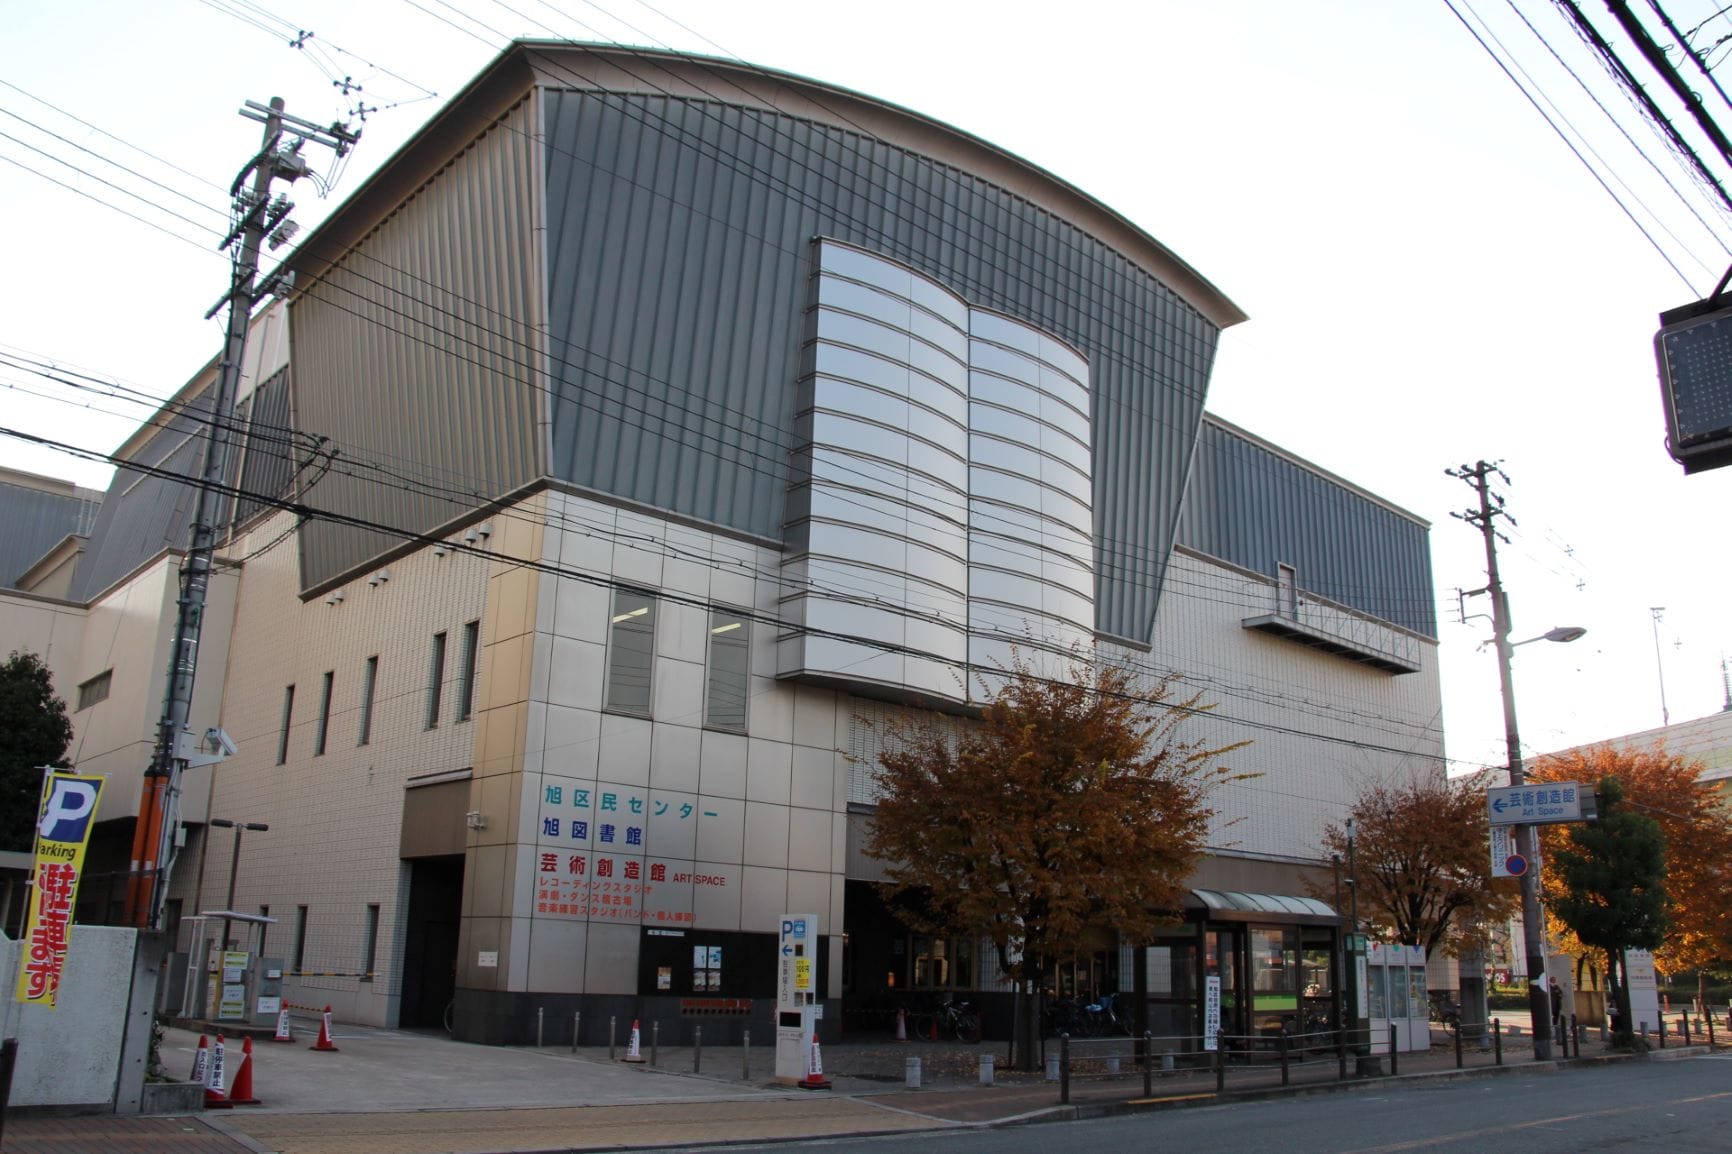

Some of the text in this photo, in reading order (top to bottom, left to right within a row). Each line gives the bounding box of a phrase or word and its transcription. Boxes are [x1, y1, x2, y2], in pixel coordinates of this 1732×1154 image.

[545, 785, 718, 819] 旭区民センター
[1509, 788, 1575, 807] 芸術創造館
[40, 780, 97, 837] P
[1522, 807, 1564, 816] Art Space
[543, 817, 642, 845] 旭図書館
[39, 843, 76, 860] arking
[540, 853, 726, 886] 芸術創造館 ART SPACE
[540, 876, 653, 895] レコーディングスタジオ
[782, 921, 794, 942] P
